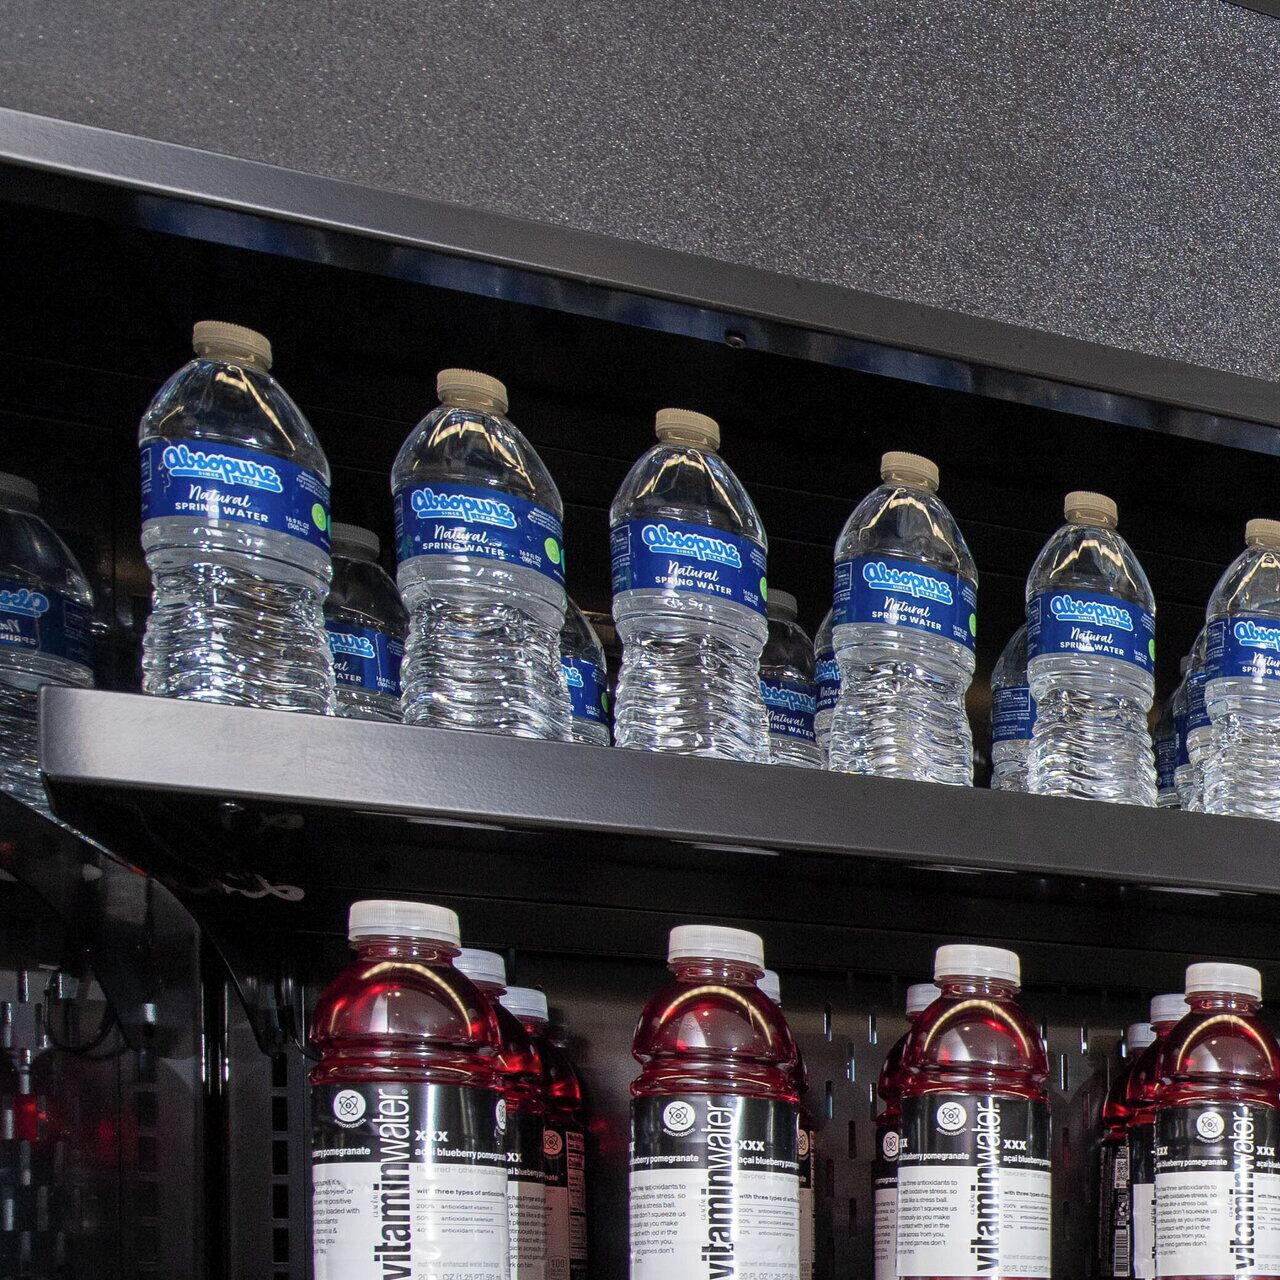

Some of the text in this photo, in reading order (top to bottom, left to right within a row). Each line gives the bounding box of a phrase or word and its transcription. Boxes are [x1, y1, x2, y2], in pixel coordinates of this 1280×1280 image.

[163, 444, 281, 488] Absopure
[188, 483, 252, 508] Natural
[411, 487, 516, 521] Absopure
[175, 502, 269, 523] SPRING WATER
[642, 524, 739, 561] Absopure
[668, 560, 720, 582] Natural
[862, 561, 952, 600] Absopure
[655, 576, 732, 596] SPRING WATER
[1050, 594, 1132, 628] Absopure
[323, 1146, 370, 1158] pomegranate
[437, 1147, 477, 1160] blueberry
[738, 1140, 765, 1152] xxx
